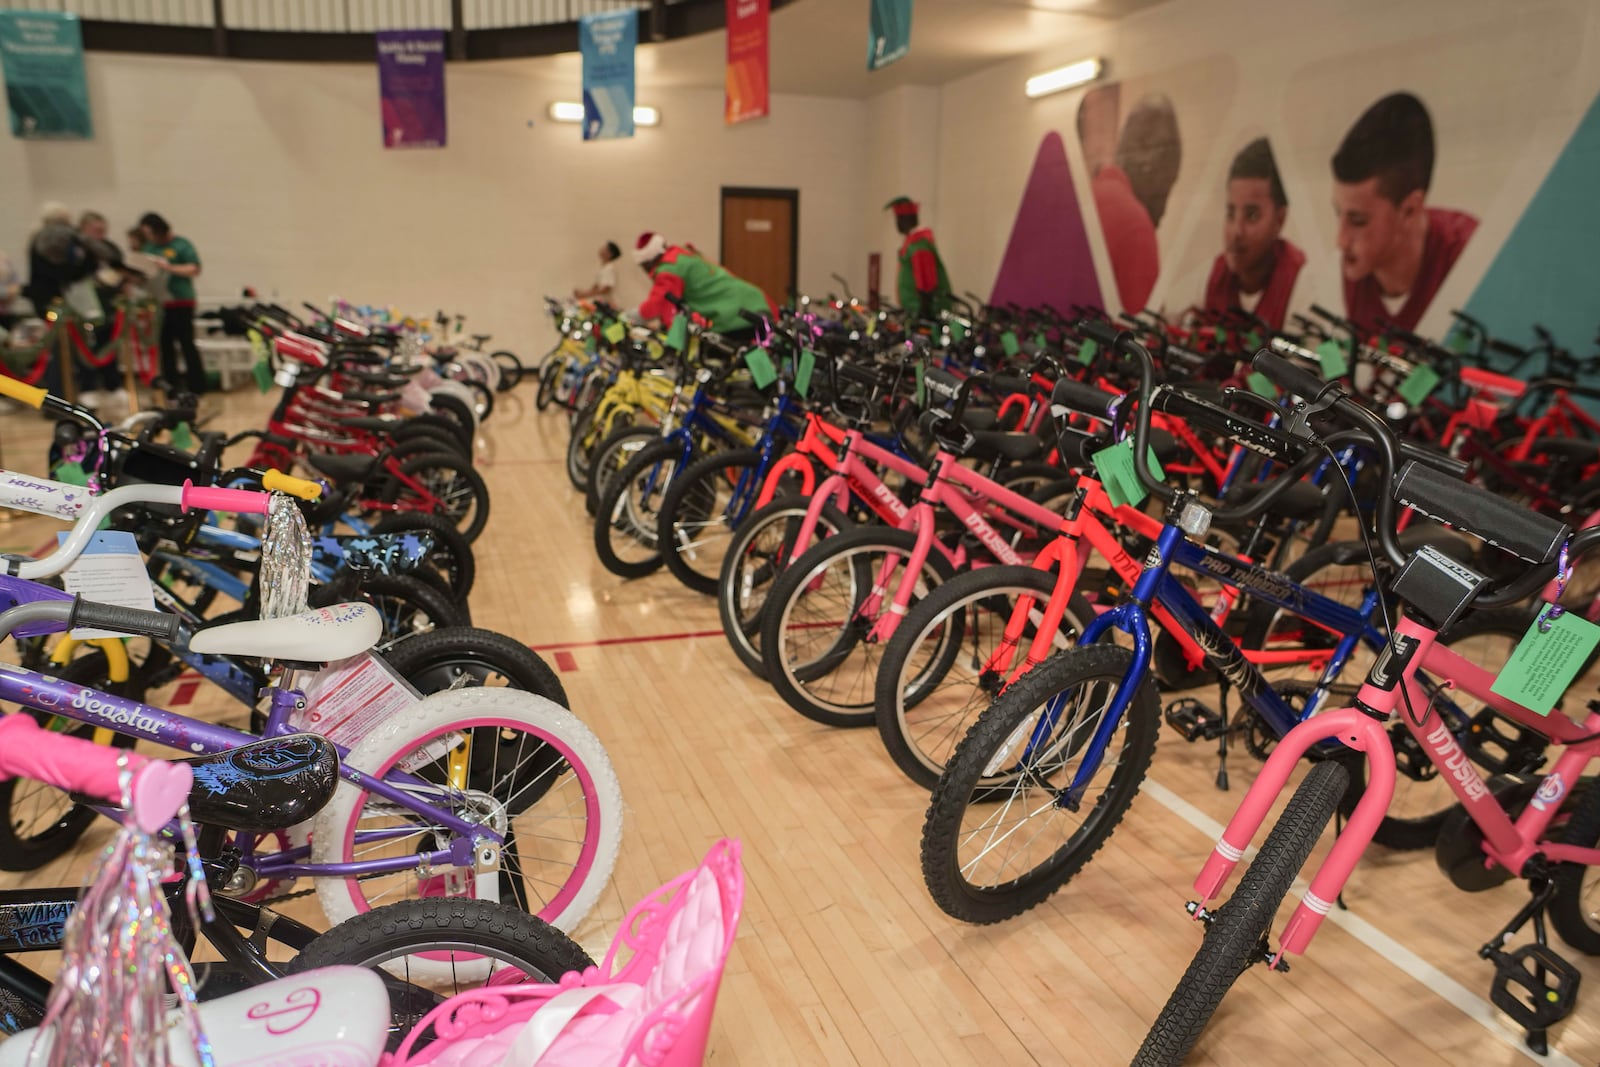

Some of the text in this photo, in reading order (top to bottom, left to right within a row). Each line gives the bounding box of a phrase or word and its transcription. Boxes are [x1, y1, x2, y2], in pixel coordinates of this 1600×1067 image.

[8, 479, 58, 493] HUFFY
[1198, 553, 1232, 576] PRO
[72, 689, 165, 734] Seastar
